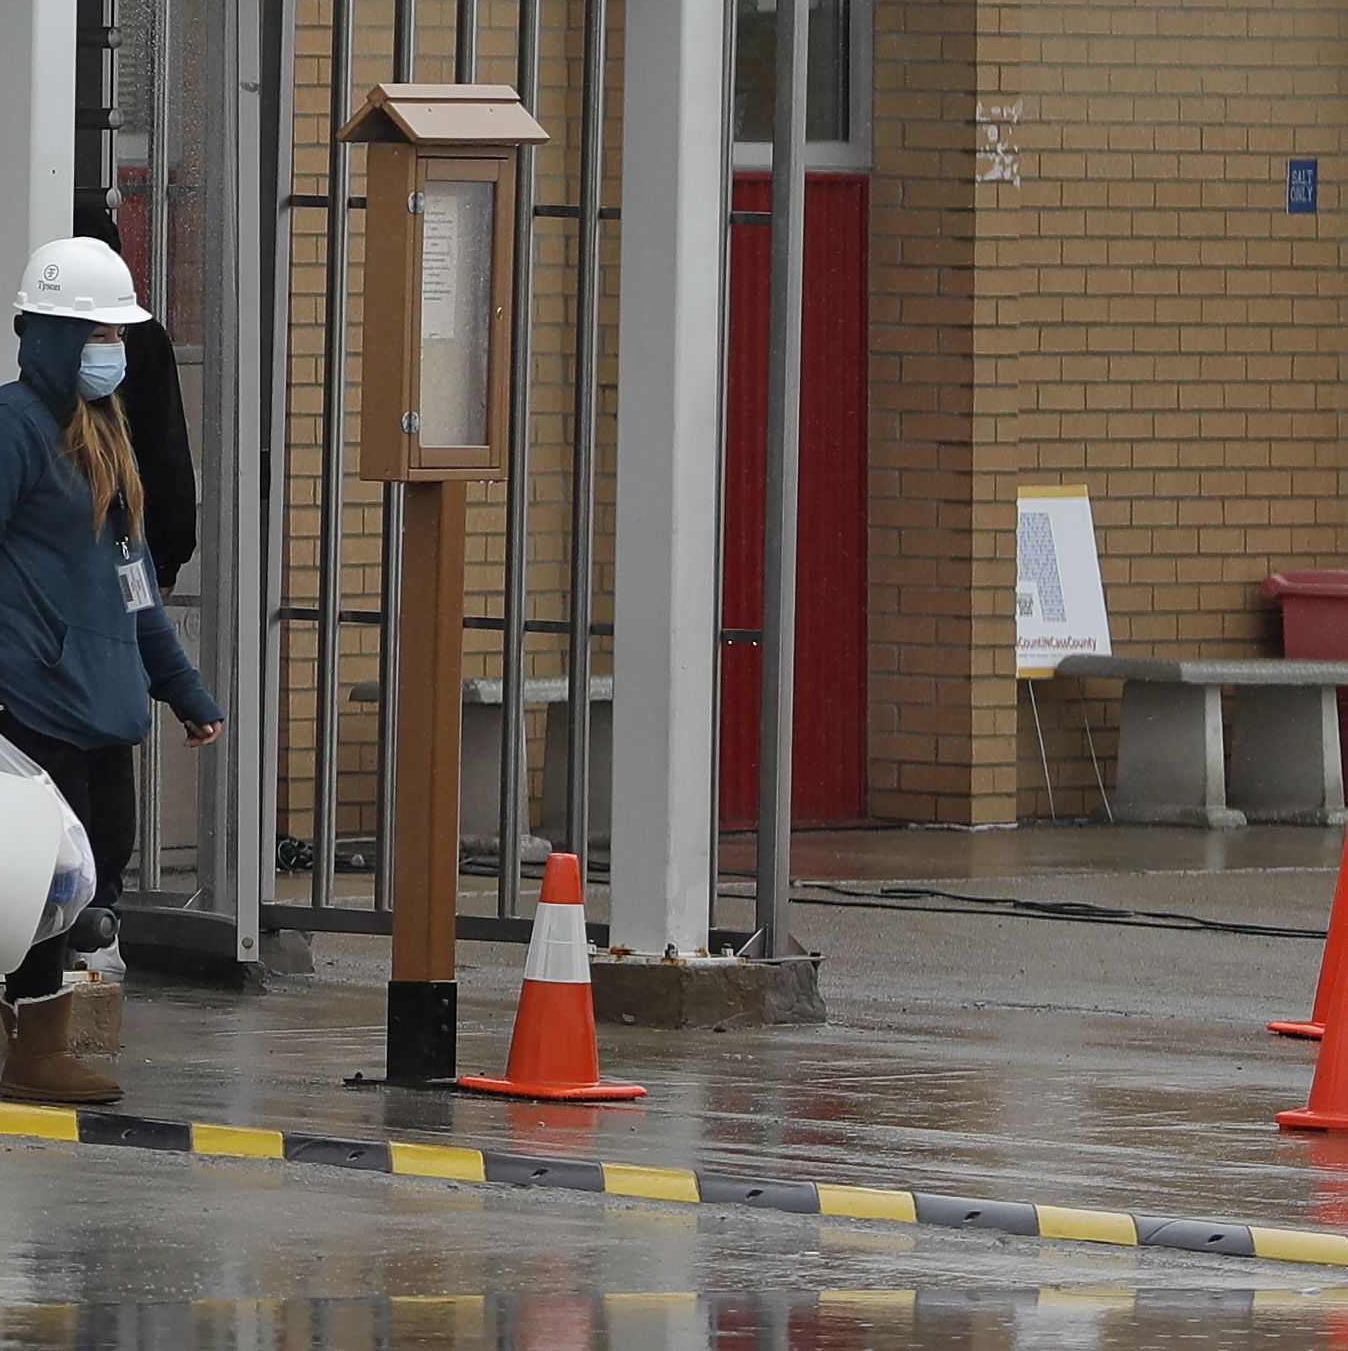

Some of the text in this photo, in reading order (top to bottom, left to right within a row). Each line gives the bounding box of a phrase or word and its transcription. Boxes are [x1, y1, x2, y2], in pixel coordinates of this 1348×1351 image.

[1291, 169, 1313, 185] SALT
[1290, 186, 1314, 203] ONLY
[38, 281, 61, 291] Tyson
